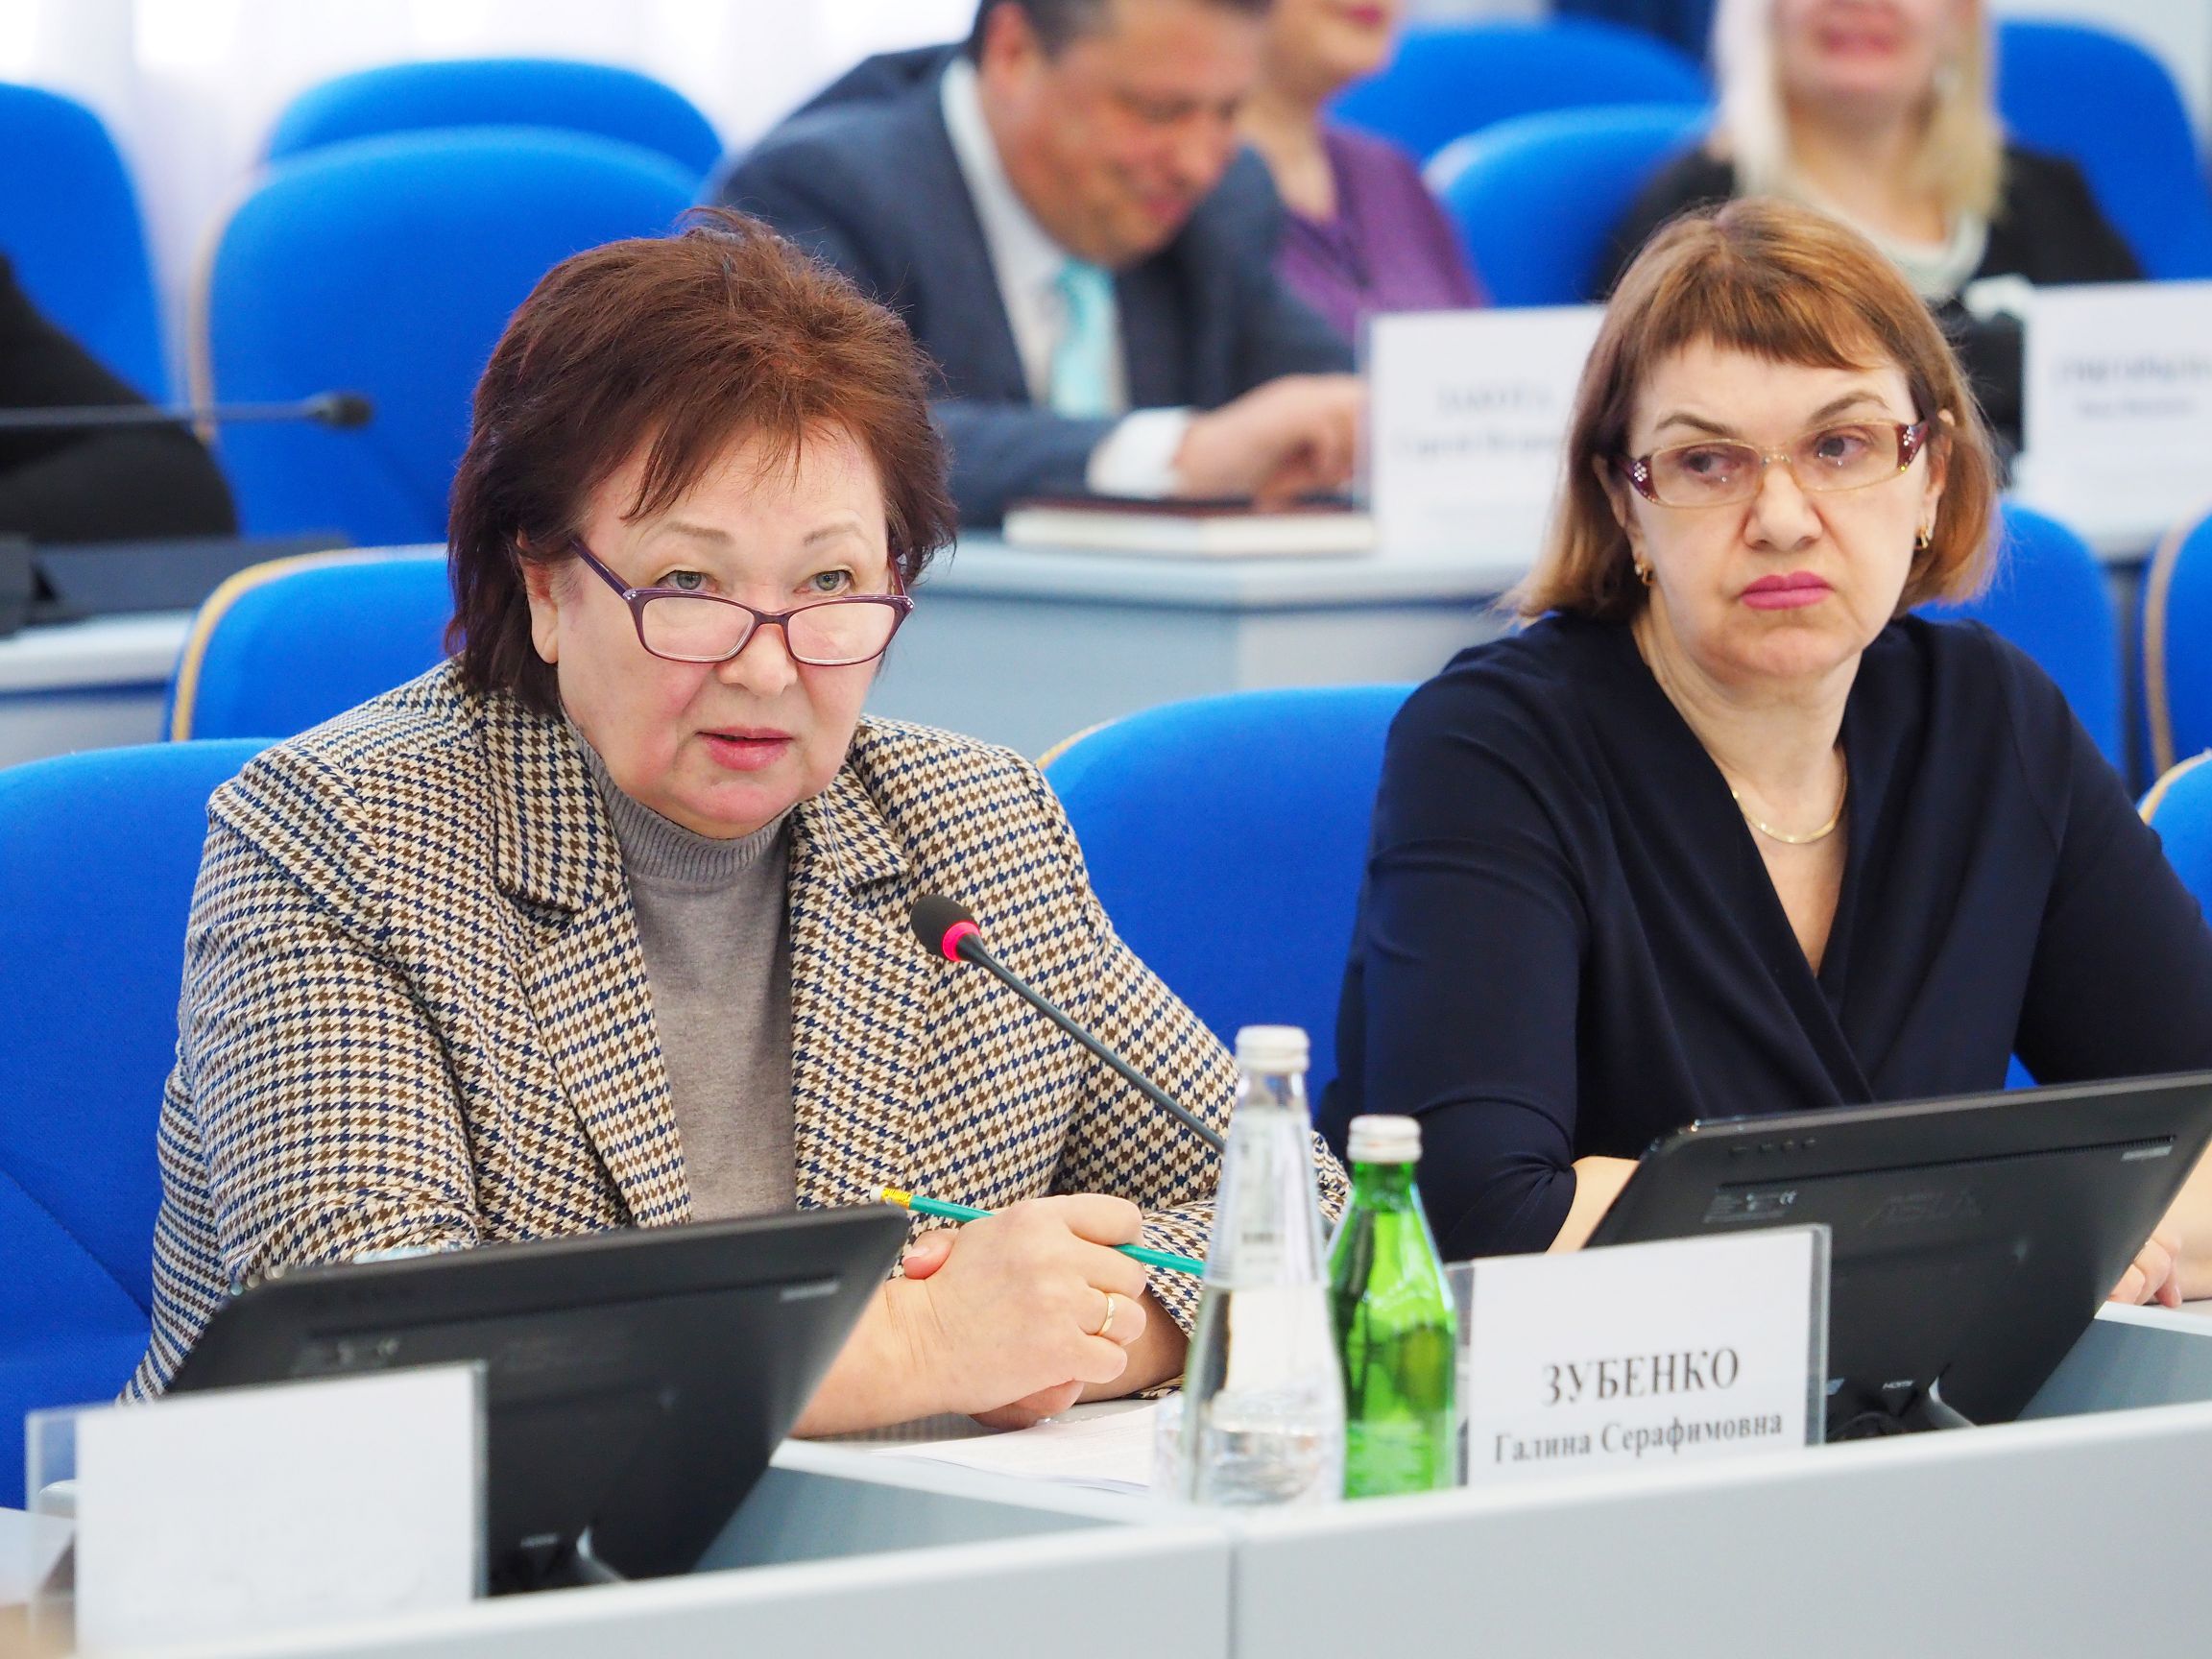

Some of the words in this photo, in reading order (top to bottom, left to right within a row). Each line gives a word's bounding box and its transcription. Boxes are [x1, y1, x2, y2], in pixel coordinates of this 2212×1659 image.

[1541, 1347, 1739, 1407] ЗУБЕНКО
[1494, 1432, 1592, 1465] Галина
[1600, 1413, 1783, 1458] Серафимовна
